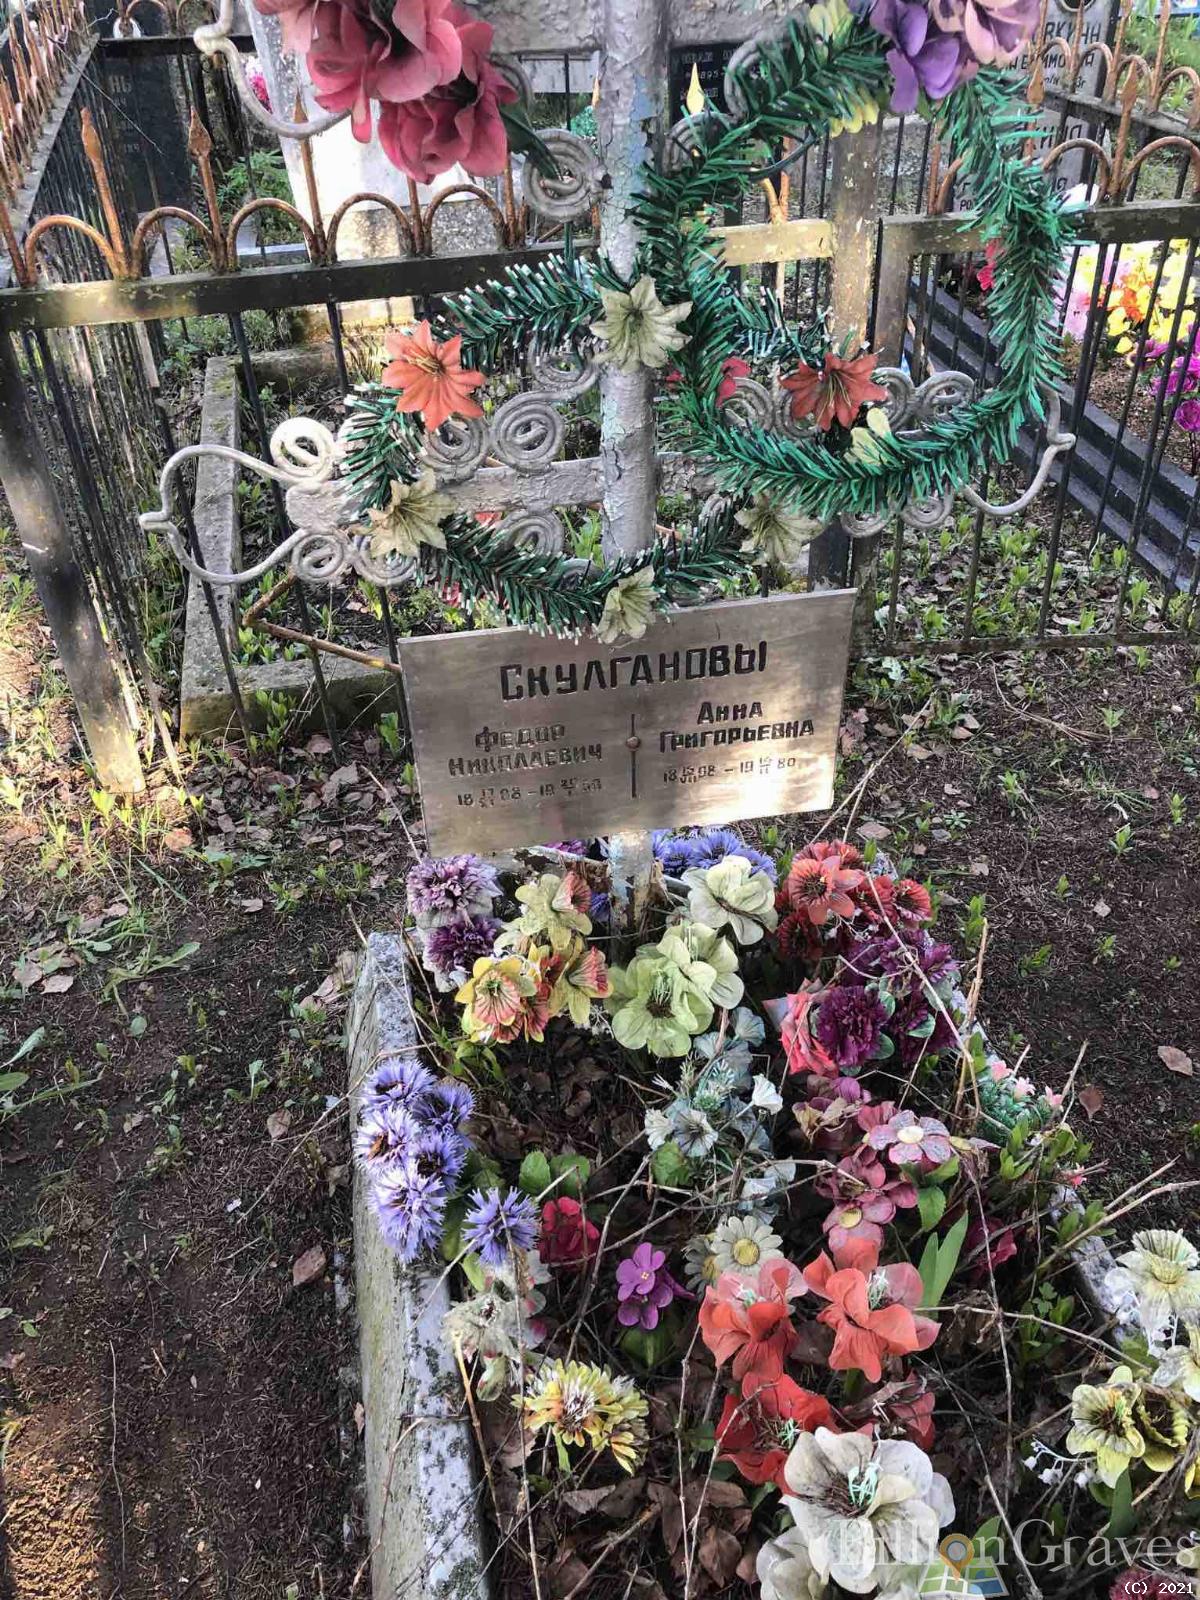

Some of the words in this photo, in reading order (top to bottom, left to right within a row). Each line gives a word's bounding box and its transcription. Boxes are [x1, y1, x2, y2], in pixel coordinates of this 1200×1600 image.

[500, 641, 767, 700] СКУЛГАНОВЫ
[475, 724, 566, 752] ФЕДОР
[659, 719, 815, 753] ГРИГОРЬЕВНА
[448, 743, 603, 777] НИКОЛАЕВИЧ
